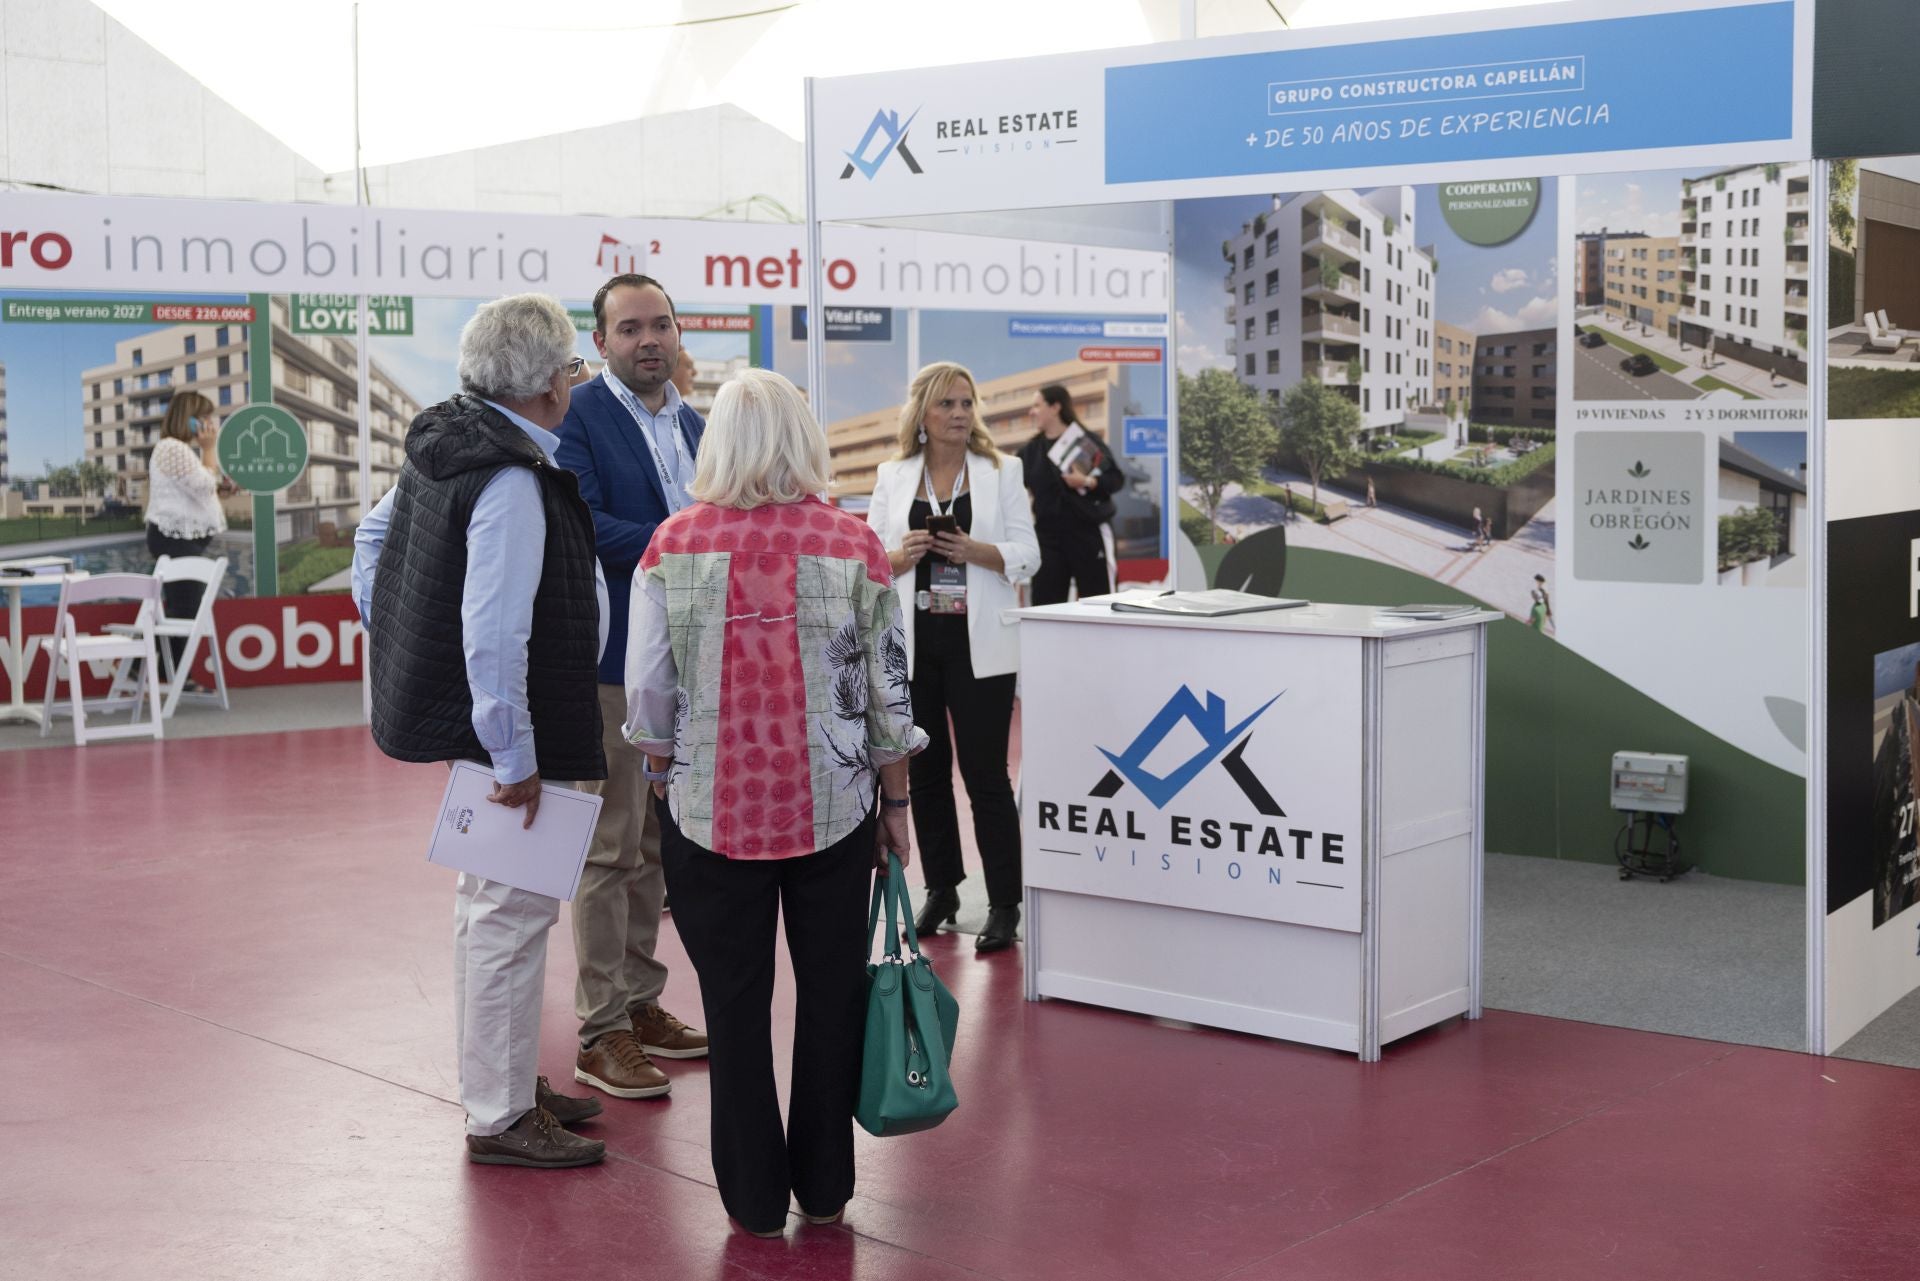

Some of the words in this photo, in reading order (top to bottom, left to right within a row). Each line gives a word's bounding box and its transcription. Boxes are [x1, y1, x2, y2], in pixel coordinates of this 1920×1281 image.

[1275, 86, 1333, 104] GRUPO
[1340, 74, 1477, 99] CONSTRUCTORA
[1484, 62, 1576, 87] CAPELLÁN
[936, 118, 988, 139] REAL
[998, 110, 1078, 134] ESTATE
[1264, 129, 1295, 148] DE
[1302, 126, 1324, 145] 50
[1331, 119, 1392, 144] AÑOS
[1400, 117, 1431, 138] DE
[1440, 103, 1610, 135] EXPERIENCIA
[963, 139, 1050, 155] VISION
[1445, 181, 1532, 196] COOPERATIVA
[1448, 198, 1529, 211] PERSONALIZABLES
[103, 216, 549, 281] inmobiliaria
[705, 249, 857, 290] meto
[299, 294, 405, 308] RESIDECIAL
[9, 303, 60, 320] Entrega
[64, 307, 110, 318] verano
[113, 305, 144, 318] 2027
[157, 307, 191, 320] DESDE
[385, 310, 406, 330] III
[825, 309, 853, 323] Vital
[855, 310, 882, 324] Este
[1576, 408, 1589, 420] 19
[1592, 409, 1665, 420] VIVIENDAS
[1684, 409, 1691, 420] 2
[1695, 409, 1704, 420] Y
[1707, 409, 1714, 420] 3
[1585, 489, 1691, 506] JARDINES
[1589, 511, 1691, 530] OBREGÓN
[1038, 801, 1146, 840] REAL
[1171, 816, 1344, 864] ESTATE
[1095, 846, 1281, 885] VISION
